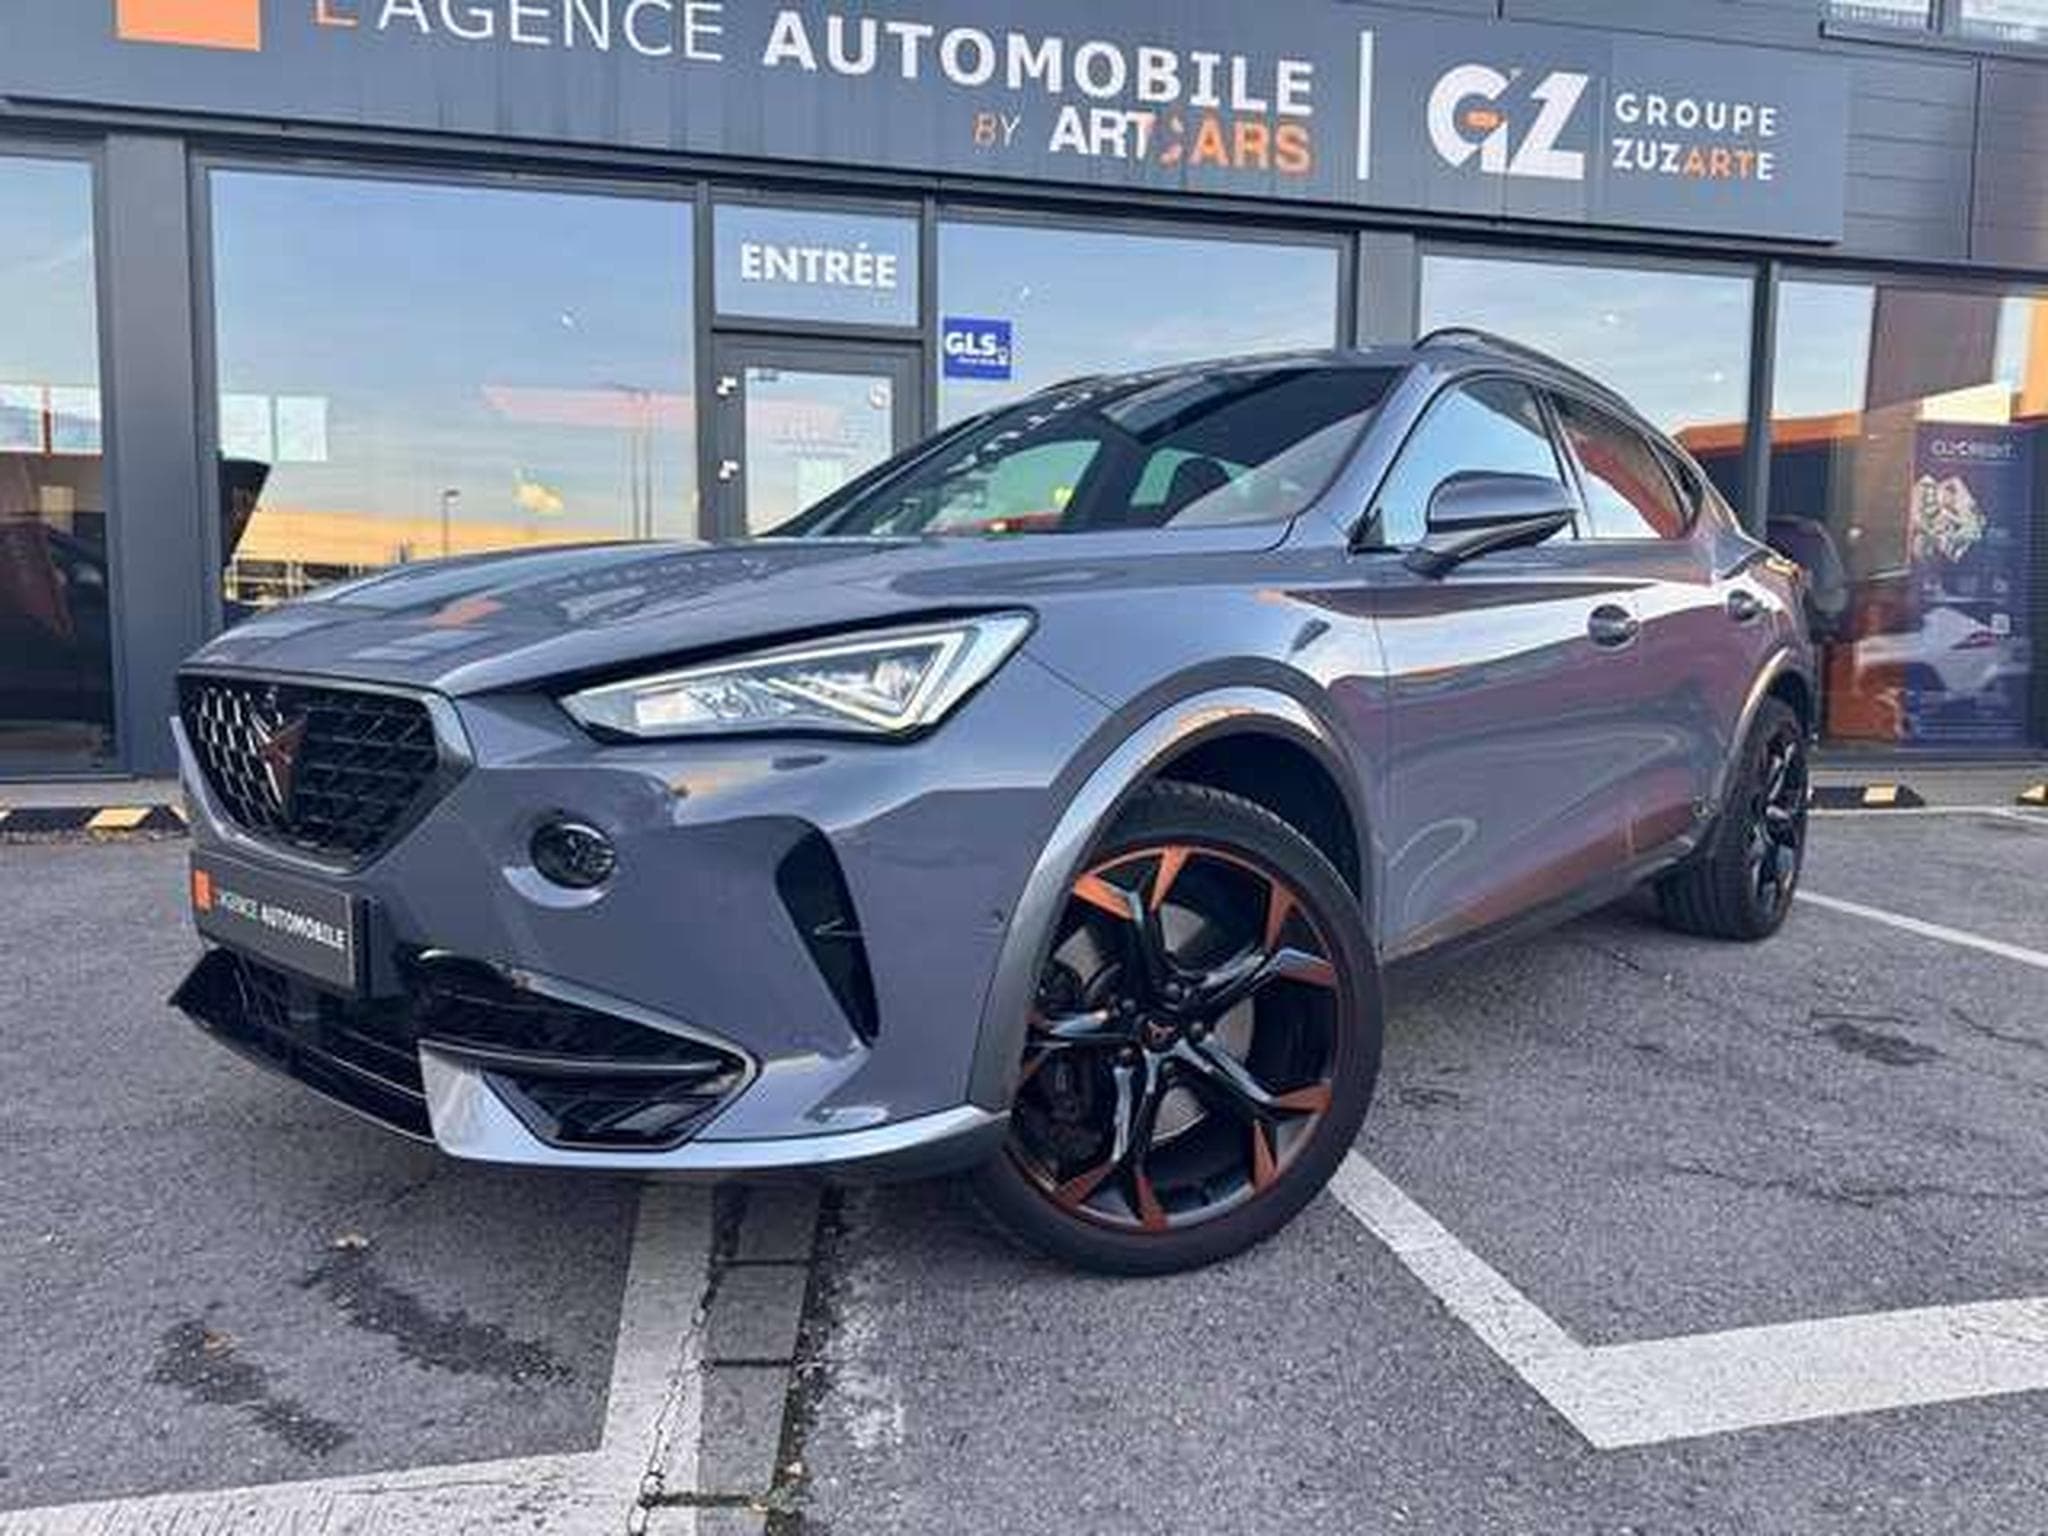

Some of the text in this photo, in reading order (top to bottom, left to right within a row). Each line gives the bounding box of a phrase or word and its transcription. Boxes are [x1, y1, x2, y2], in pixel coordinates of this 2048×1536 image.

[313, 0, 1314, 116] LAGENCE AUTOMOBILE
[973, 112, 1021, 147] BY
[1614, 93, 1777, 137] GROUPE
[1612, 138, 1775, 181] ZUZARTE
[740, 242, 898, 287] ENTRÉE
[945, 331, 997, 356] GLS
